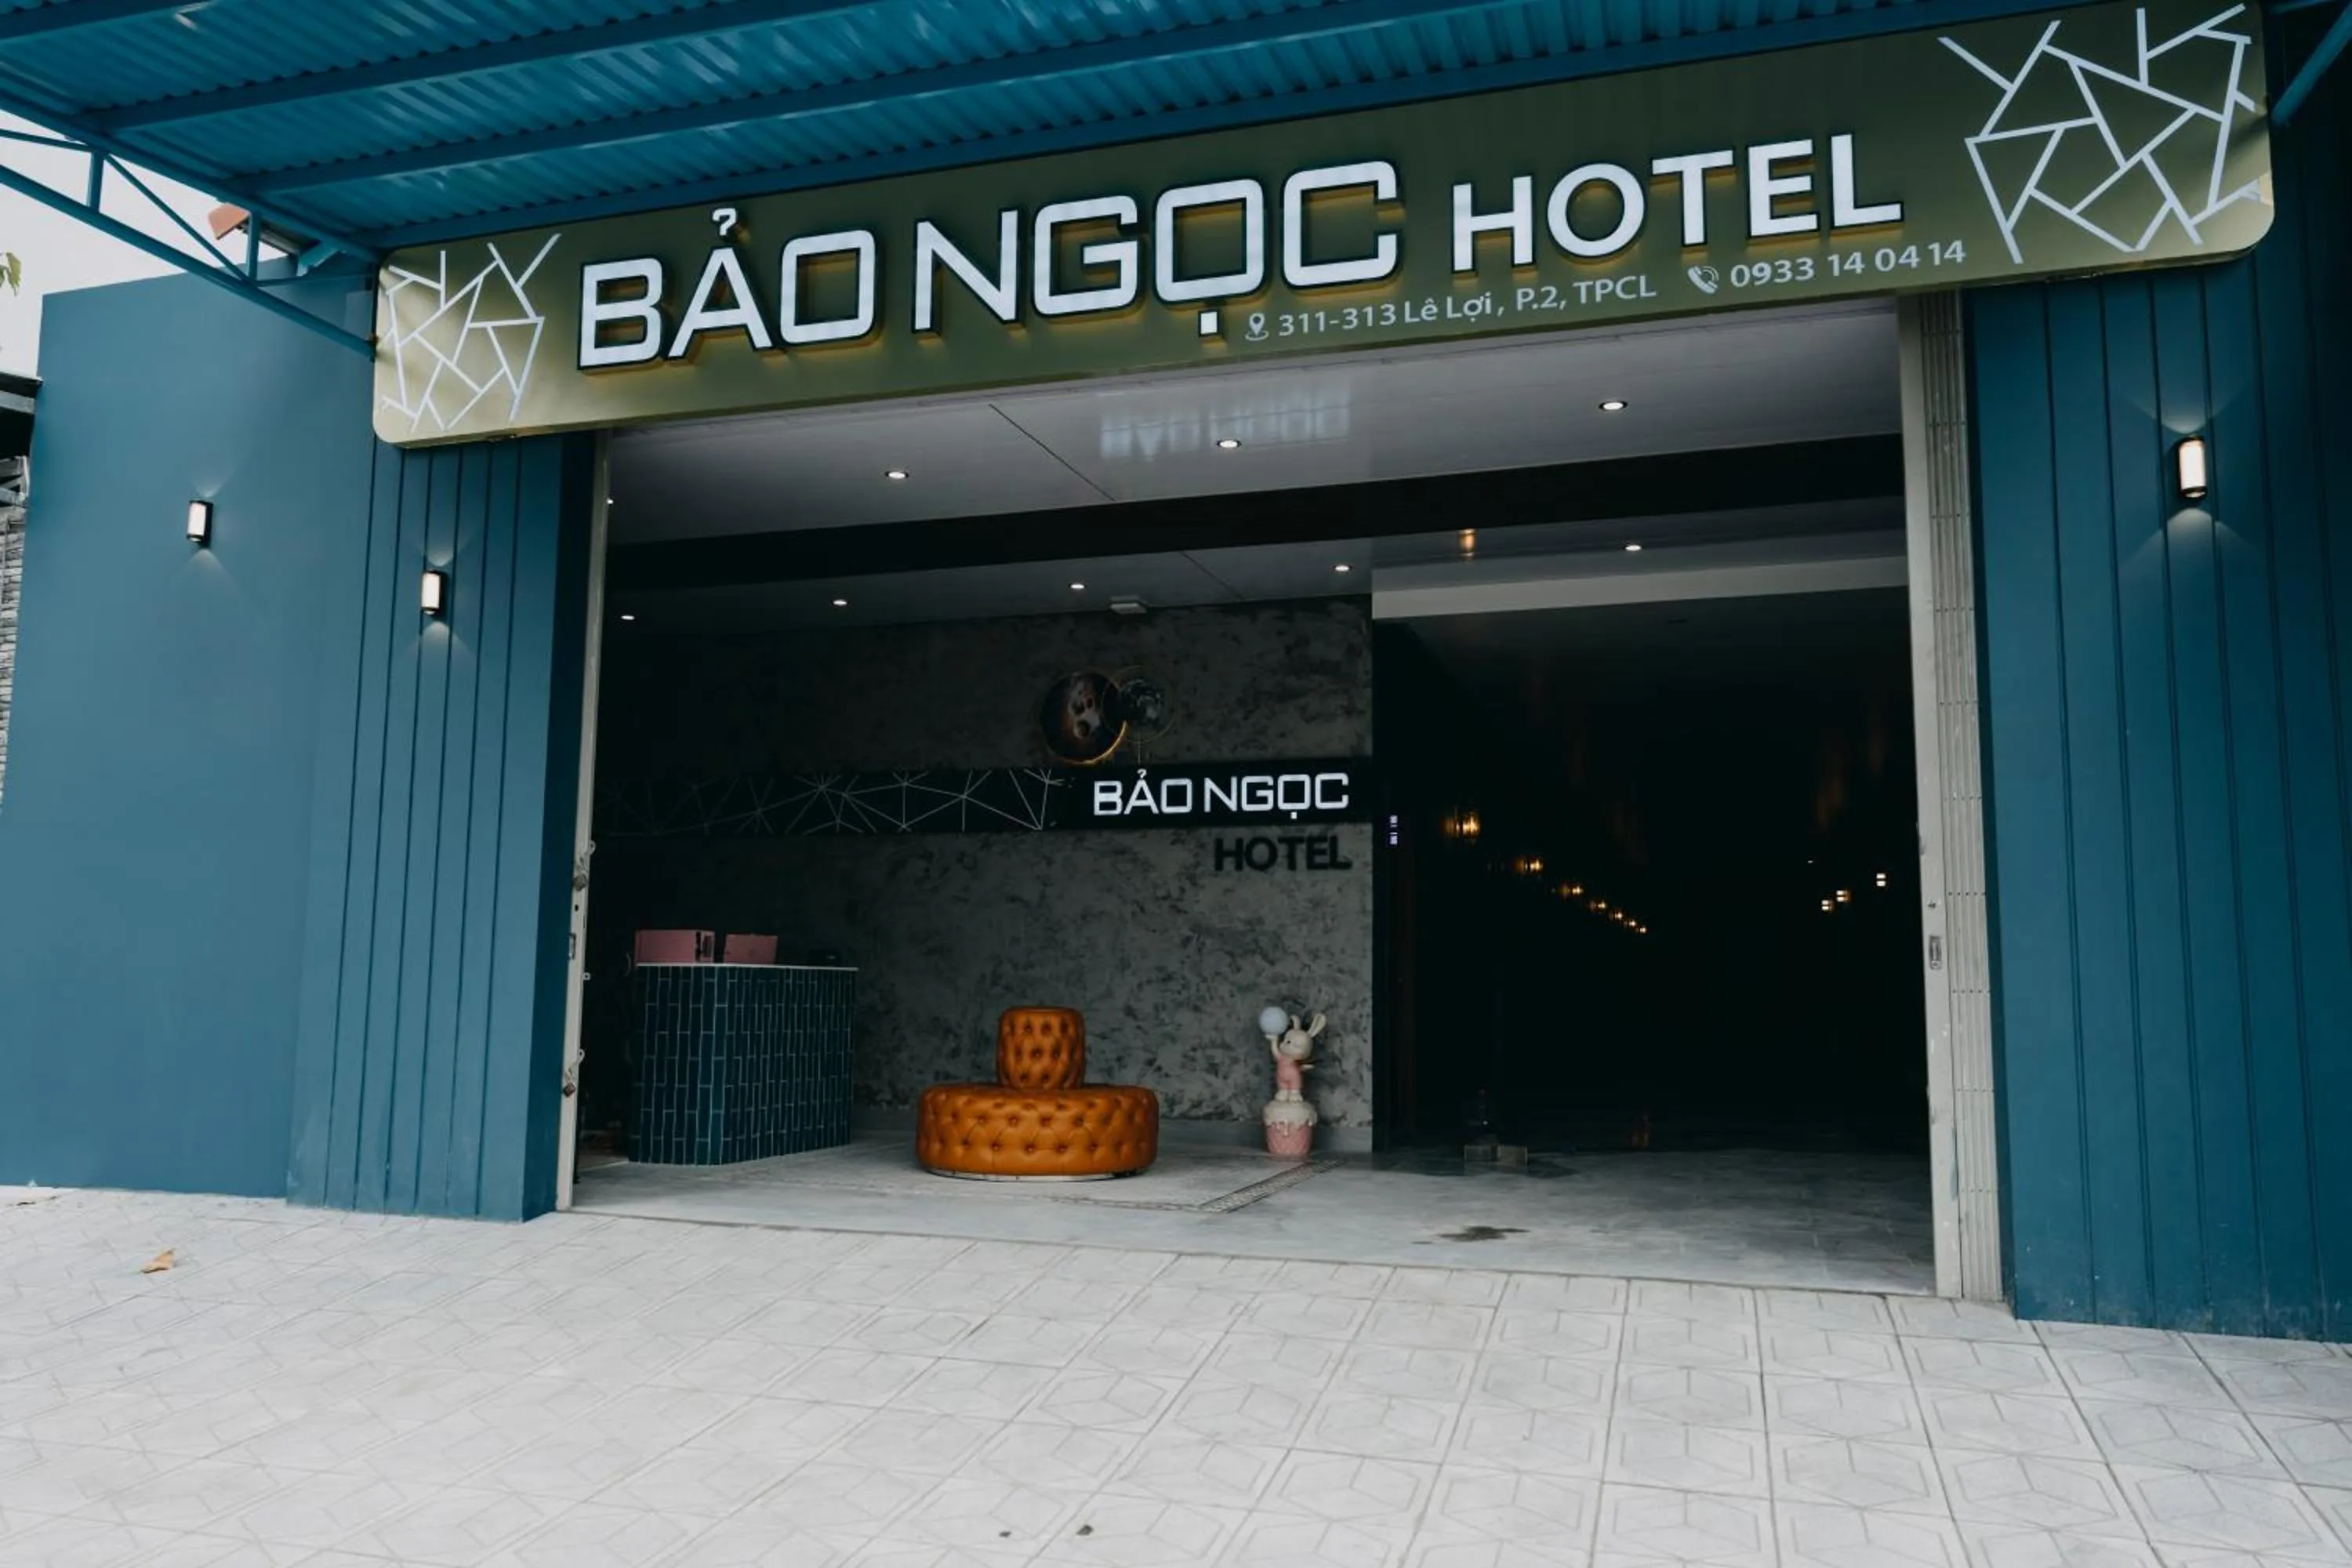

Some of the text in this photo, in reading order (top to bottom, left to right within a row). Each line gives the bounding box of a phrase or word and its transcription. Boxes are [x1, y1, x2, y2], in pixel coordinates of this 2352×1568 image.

[579, 133, 1904, 371] BẢO NGỌC HOTEL
[1730, 239, 1966, 288] 0933 14 04 14
[1279, 304, 1397, 336] 311-313
[1404, 297, 1439, 324] Lê
[1516, 285, 1567, 311] P.2,
[1573, 275, 1657, 304] TPCL
[1093, 769, 1350, 820] BẢO NGỌC
[1214, 836, 1352, 872] HOTEL
